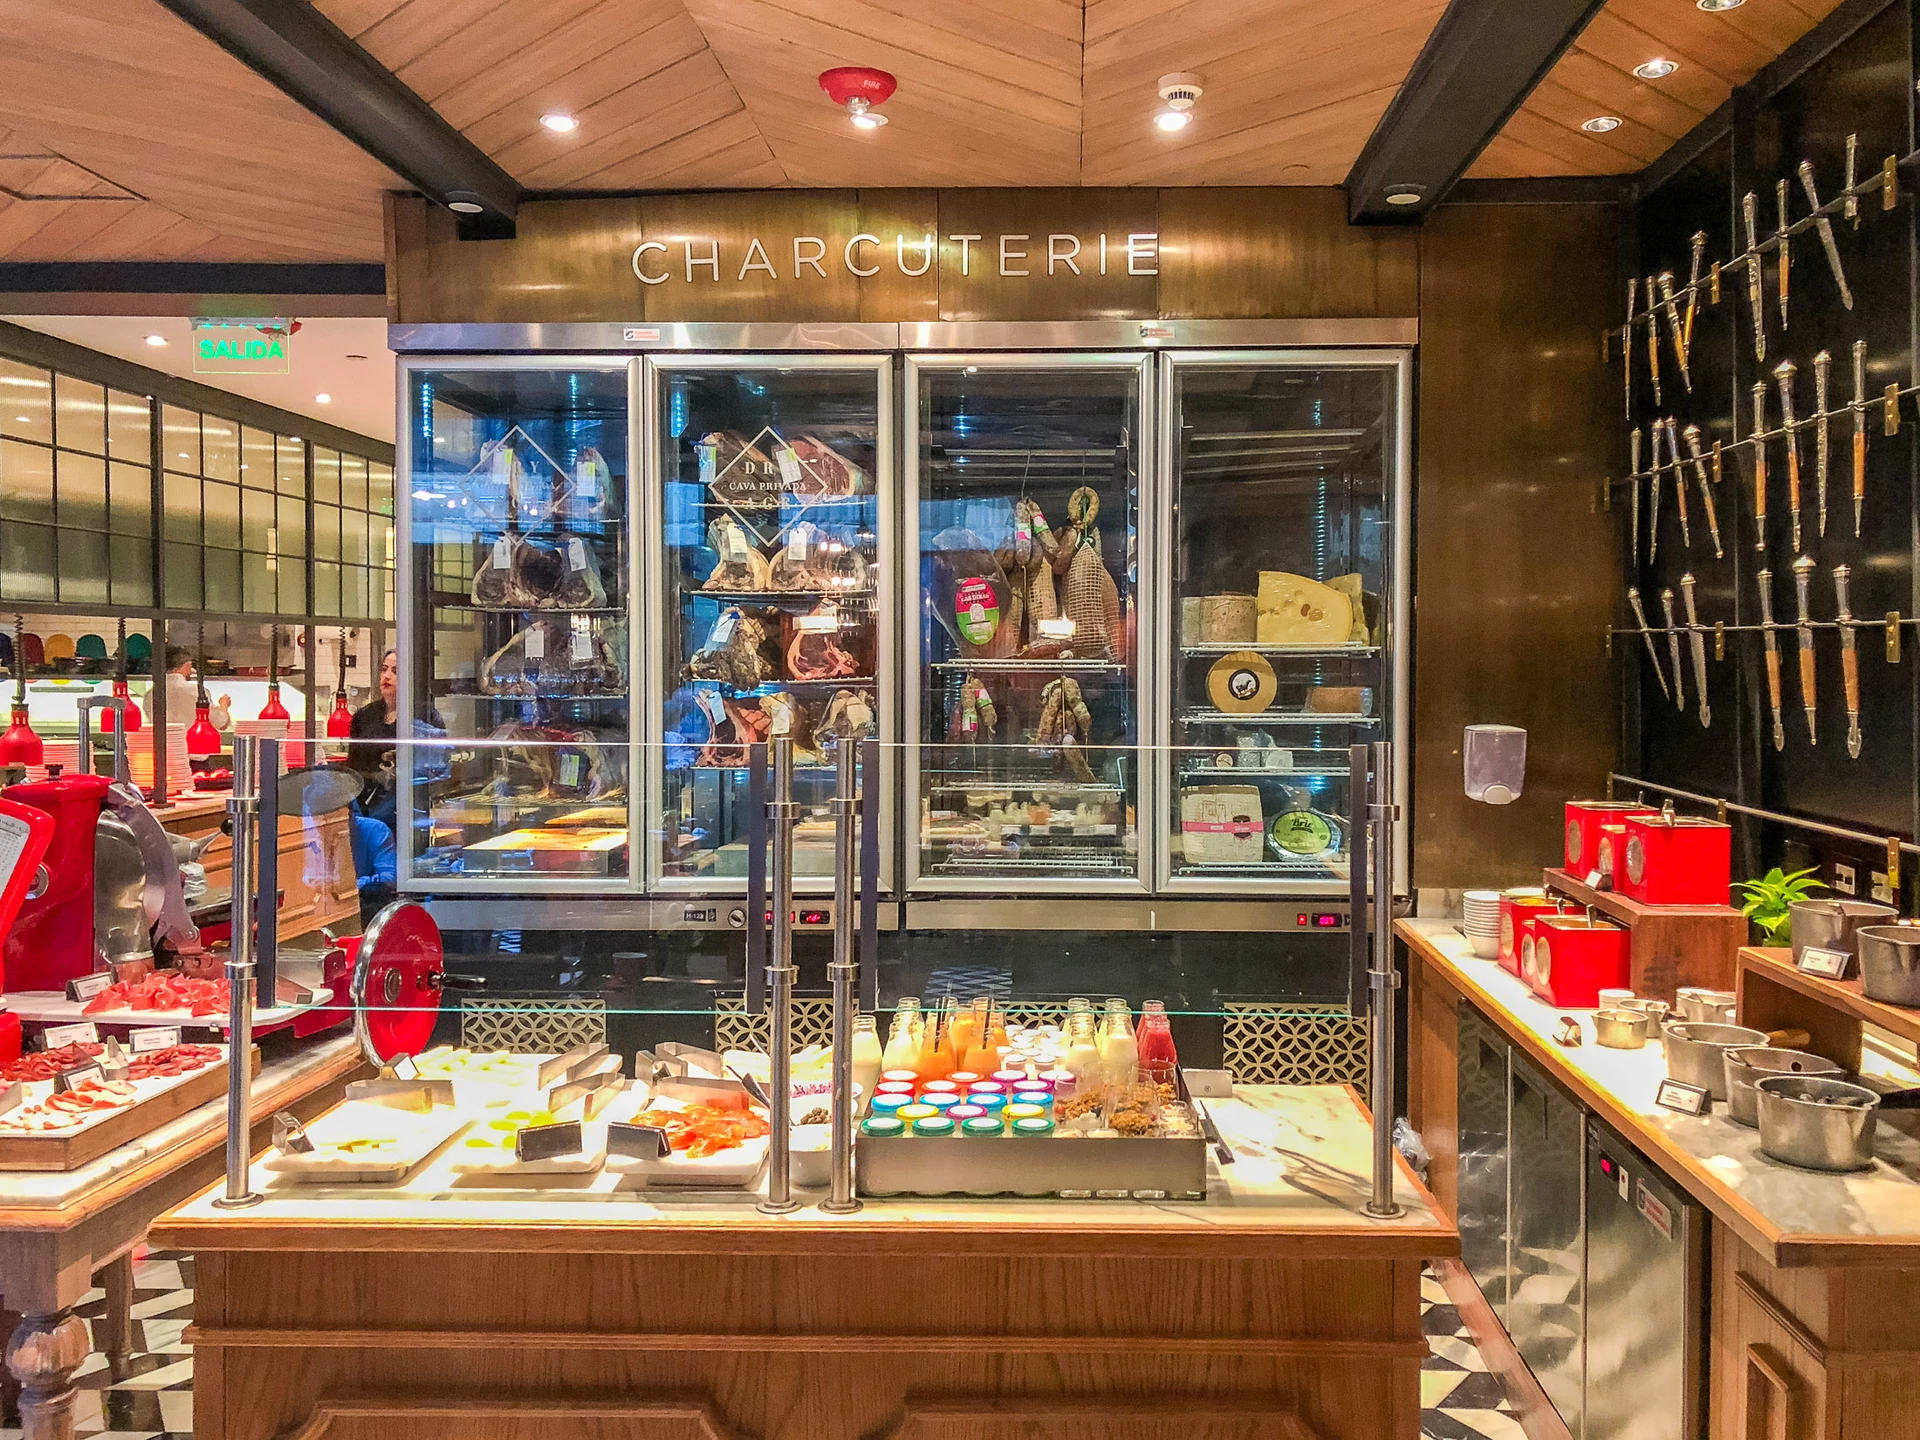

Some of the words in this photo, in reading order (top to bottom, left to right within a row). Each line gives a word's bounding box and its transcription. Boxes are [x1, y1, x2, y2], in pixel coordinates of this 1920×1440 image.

[863, 79, 882, 90] FIRE
[631, 232, 1160, 286] CHARCUTERIE
[199, 338, 285, 360] SALIDA
[728, 481, 757, 491] CAVA
[759, 481, 808, 491] PRIVADA
